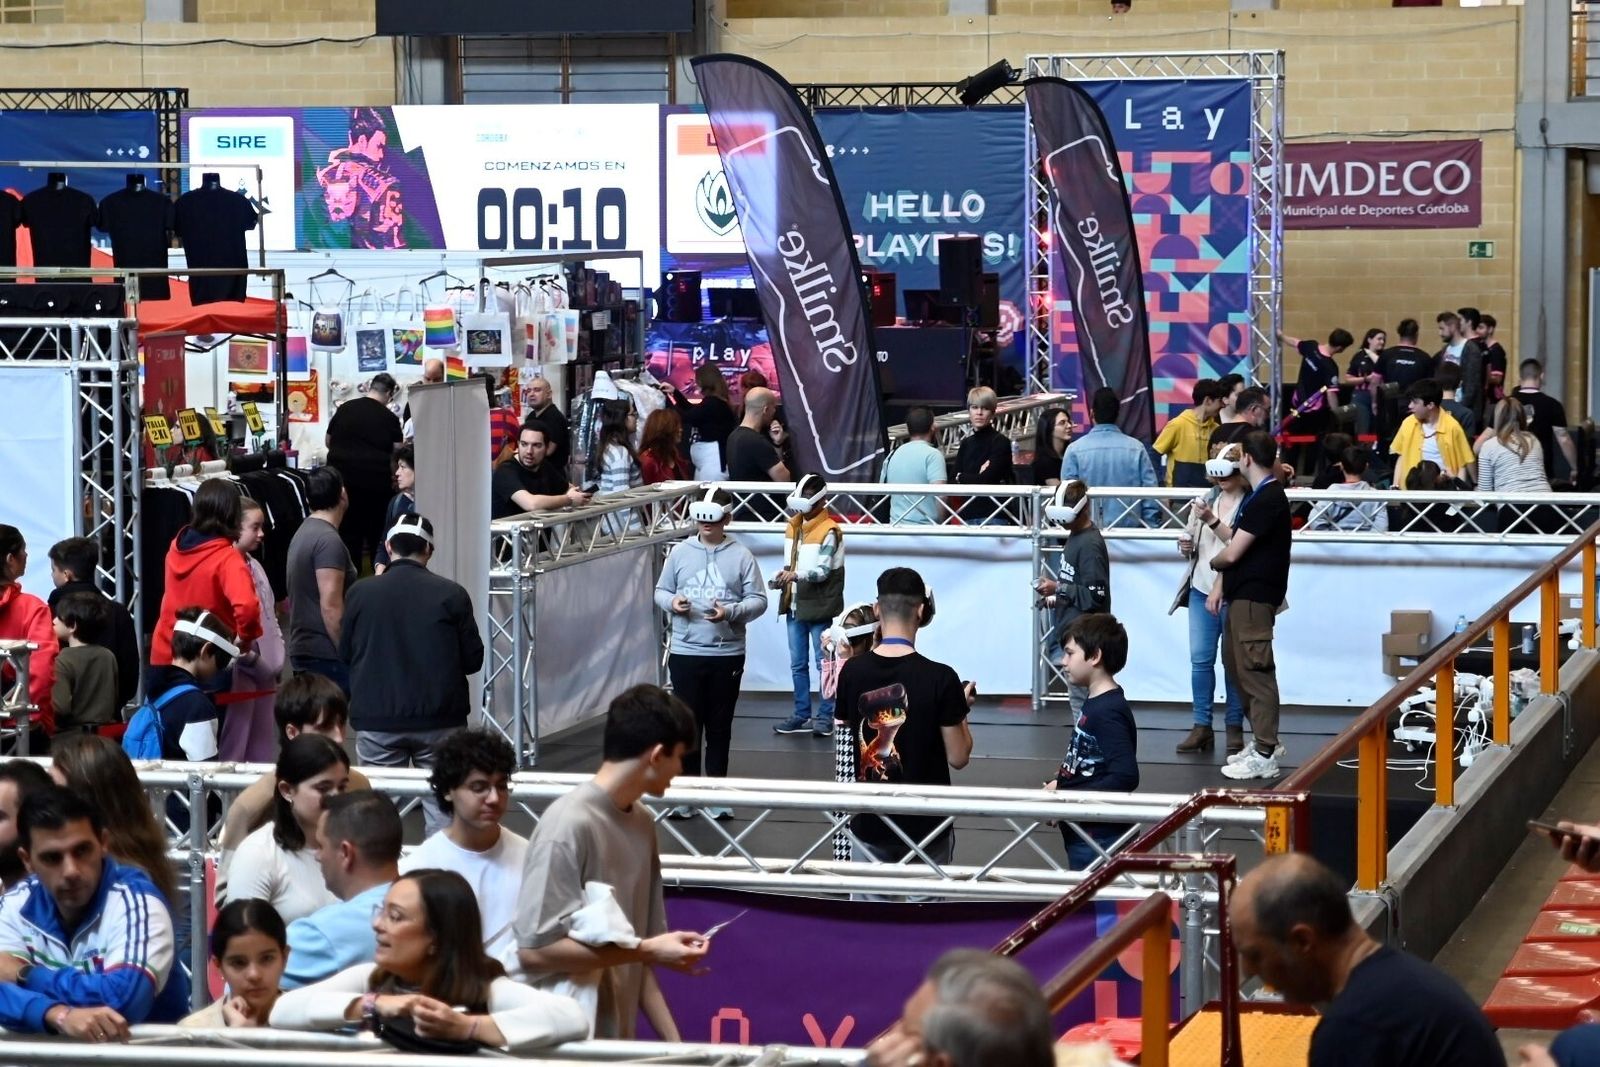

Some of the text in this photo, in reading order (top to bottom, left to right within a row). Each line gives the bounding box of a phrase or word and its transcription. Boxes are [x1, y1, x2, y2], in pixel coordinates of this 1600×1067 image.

[217, 136, 266, 149] SIRE
[484, 161, 625, 171] COMENZAMOS EN
[1284, 160, 1471, 197] IMDECO
[871, 193, 985, 218] HELLO
[1340, 205, 1357, 215] de
[1360, 203, 1414, 218] Deportes
[1417, 202, 1470, 214] Córdoba
[477, 187, 627, 250] 00:10
[852, 233, 1015, 257] PLAYS!
[147, 419, 166, 429] TALLA
[683, 584, 732, 600] adidas
